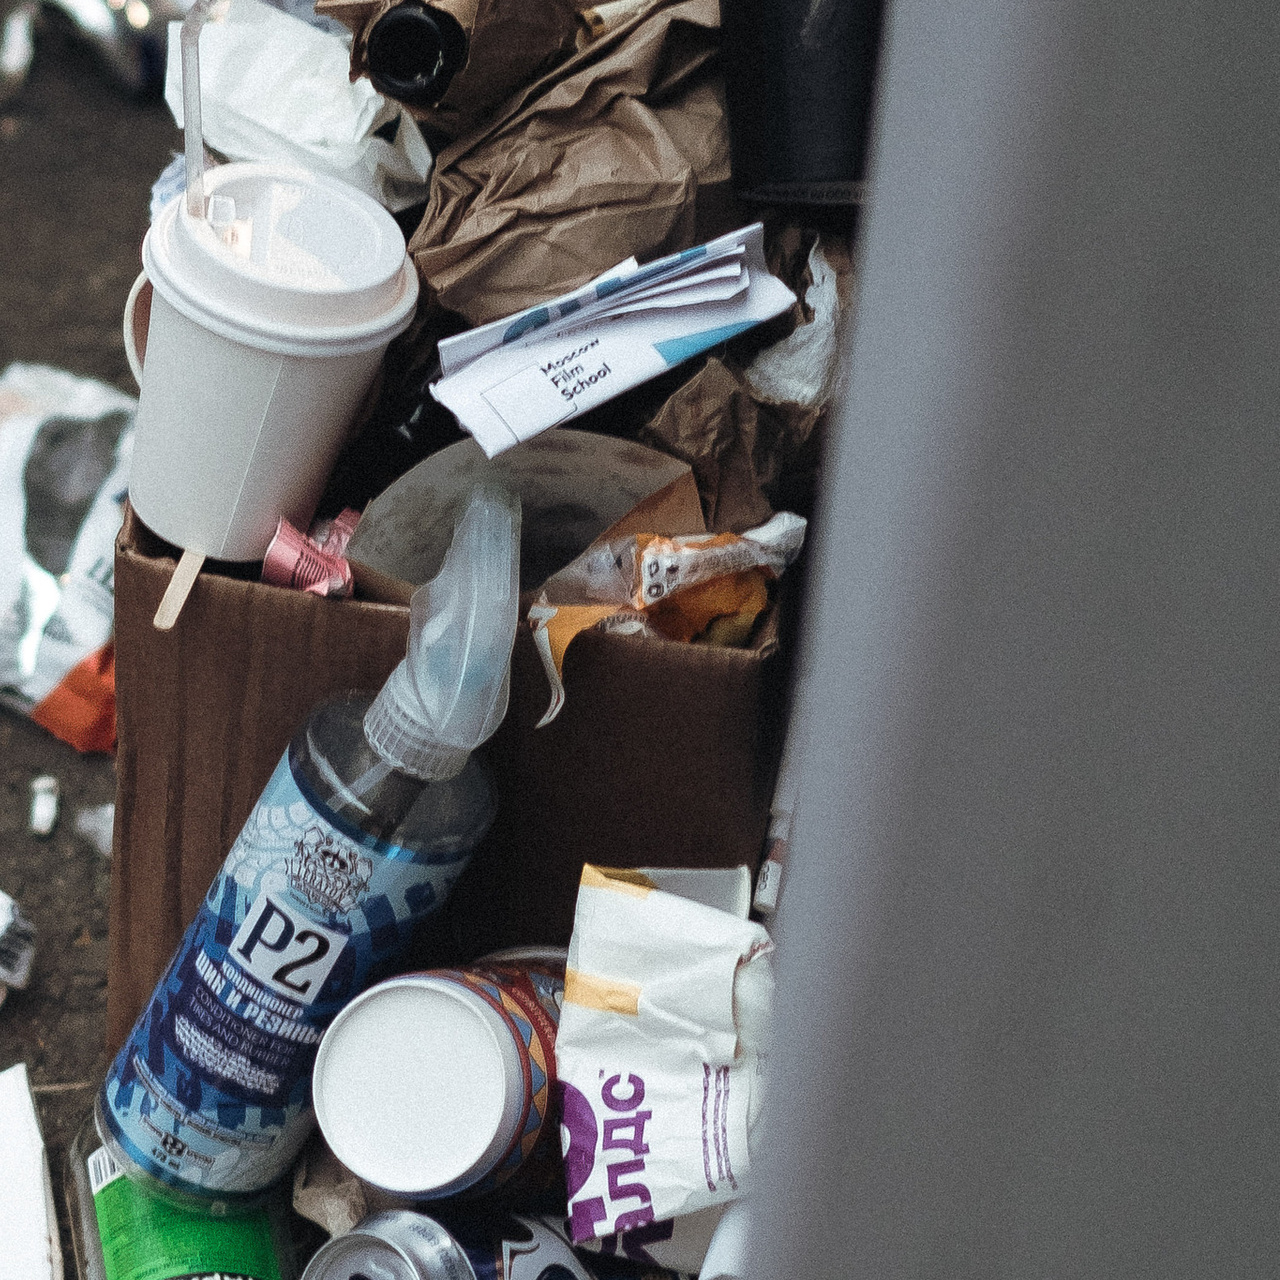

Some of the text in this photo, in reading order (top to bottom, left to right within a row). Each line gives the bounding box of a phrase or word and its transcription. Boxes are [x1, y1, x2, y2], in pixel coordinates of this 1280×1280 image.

[538, 337, 600, 377] Moscow
[551, 363, 585, 389] Film
[560, 363, 612, 401] School
[236, 896, 331, 995] P2
[194, 948, 225, 995] ШИН
[224, 989, 242, 1010] И
[192, 985, 273, 1050] CONDITIONER
[211, 1021, 240, 1047] AND
